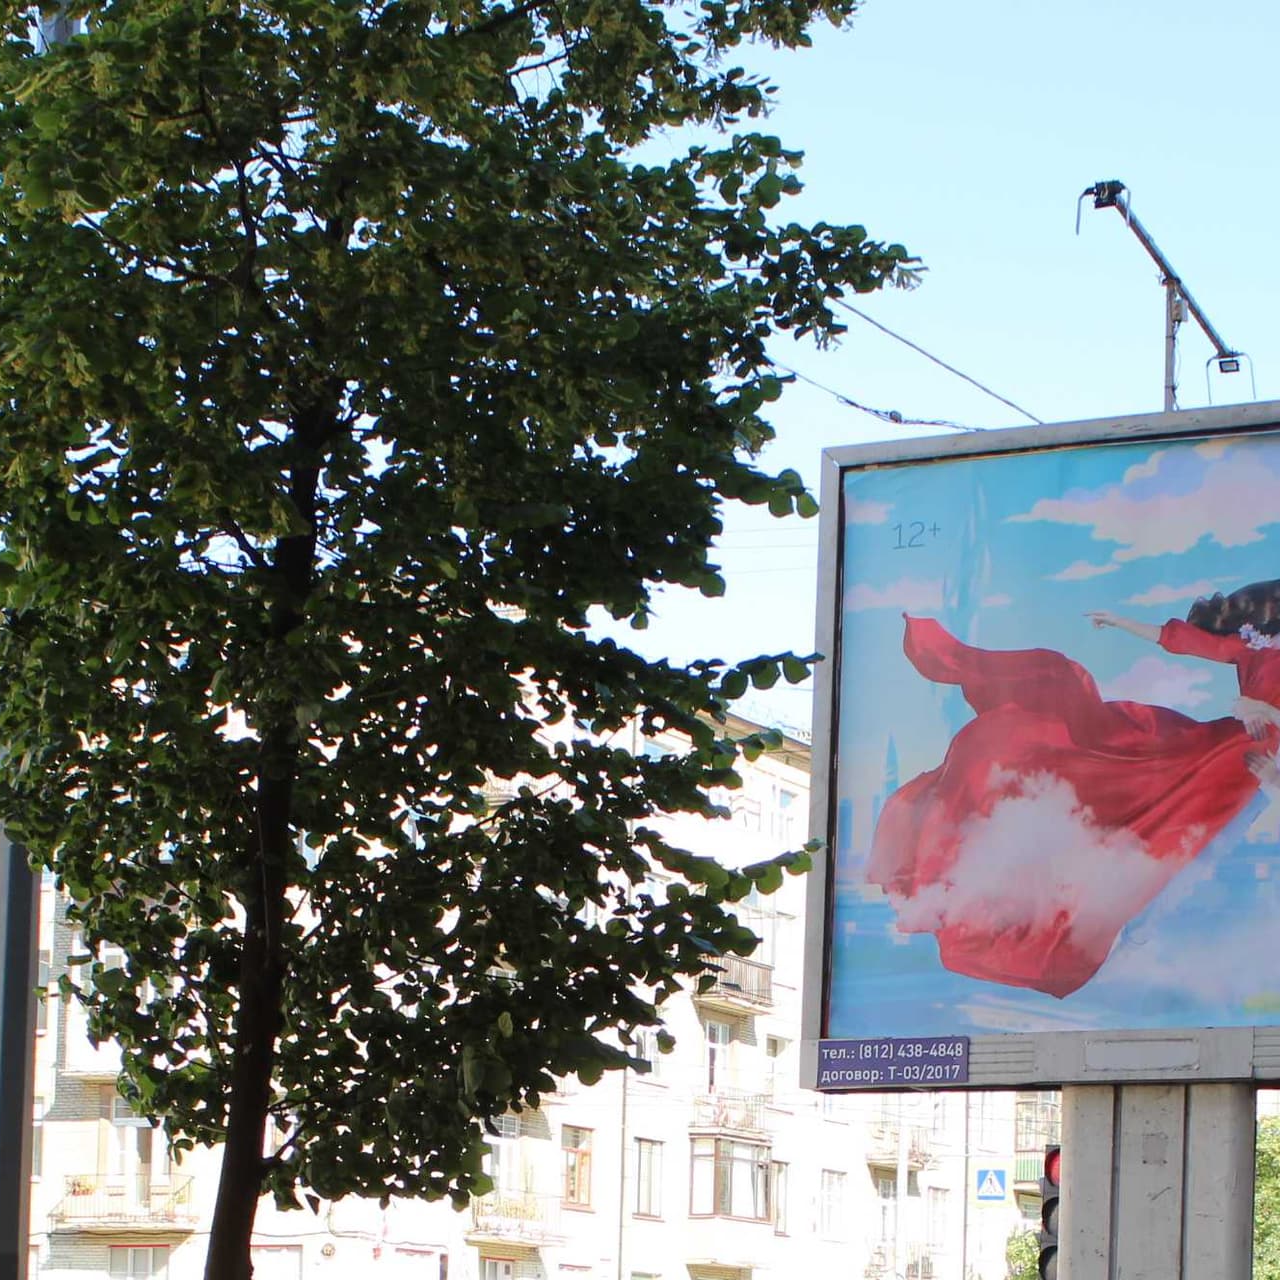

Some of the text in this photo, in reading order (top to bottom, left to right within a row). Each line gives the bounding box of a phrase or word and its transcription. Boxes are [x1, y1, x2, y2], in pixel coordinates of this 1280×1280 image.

[892, 521, 942, 550] 12+
[821, 1042, 964, 1060] тел.: (812) 438-4848
[820, 1064, 961, 1083] договор: Т-03/2017
